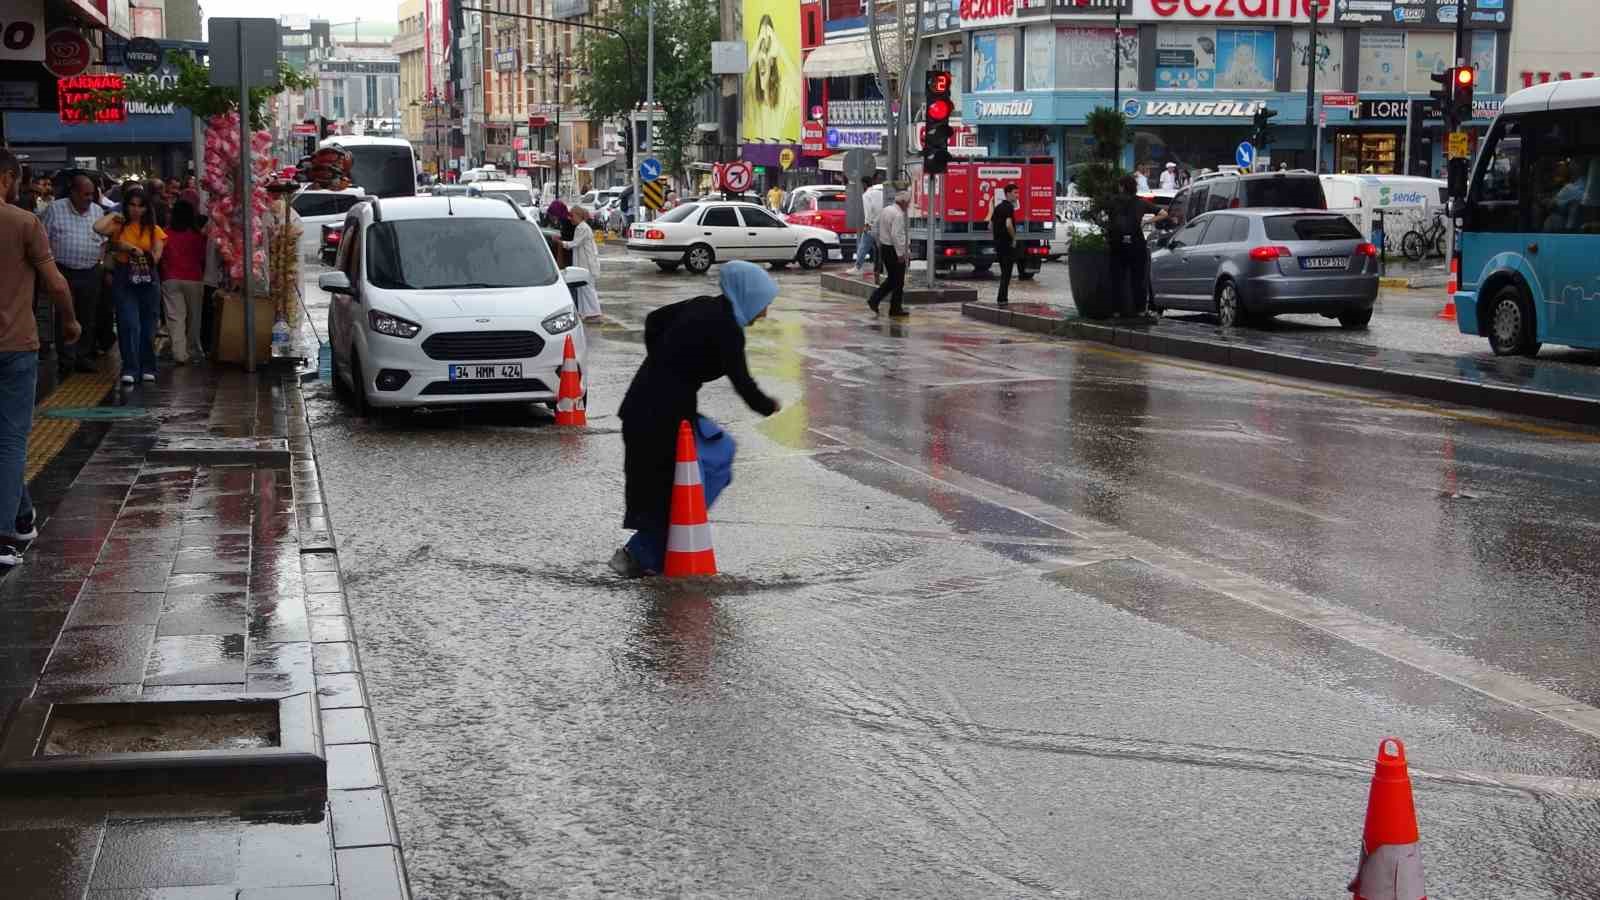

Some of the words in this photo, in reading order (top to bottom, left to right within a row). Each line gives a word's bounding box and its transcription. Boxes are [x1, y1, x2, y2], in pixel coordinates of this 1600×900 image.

[936, 75, 946, 91] 2
[456, 366, 469, 378] 34
[475, 365, 495, 378] HMM
[501, 364, 520, 377] 424
